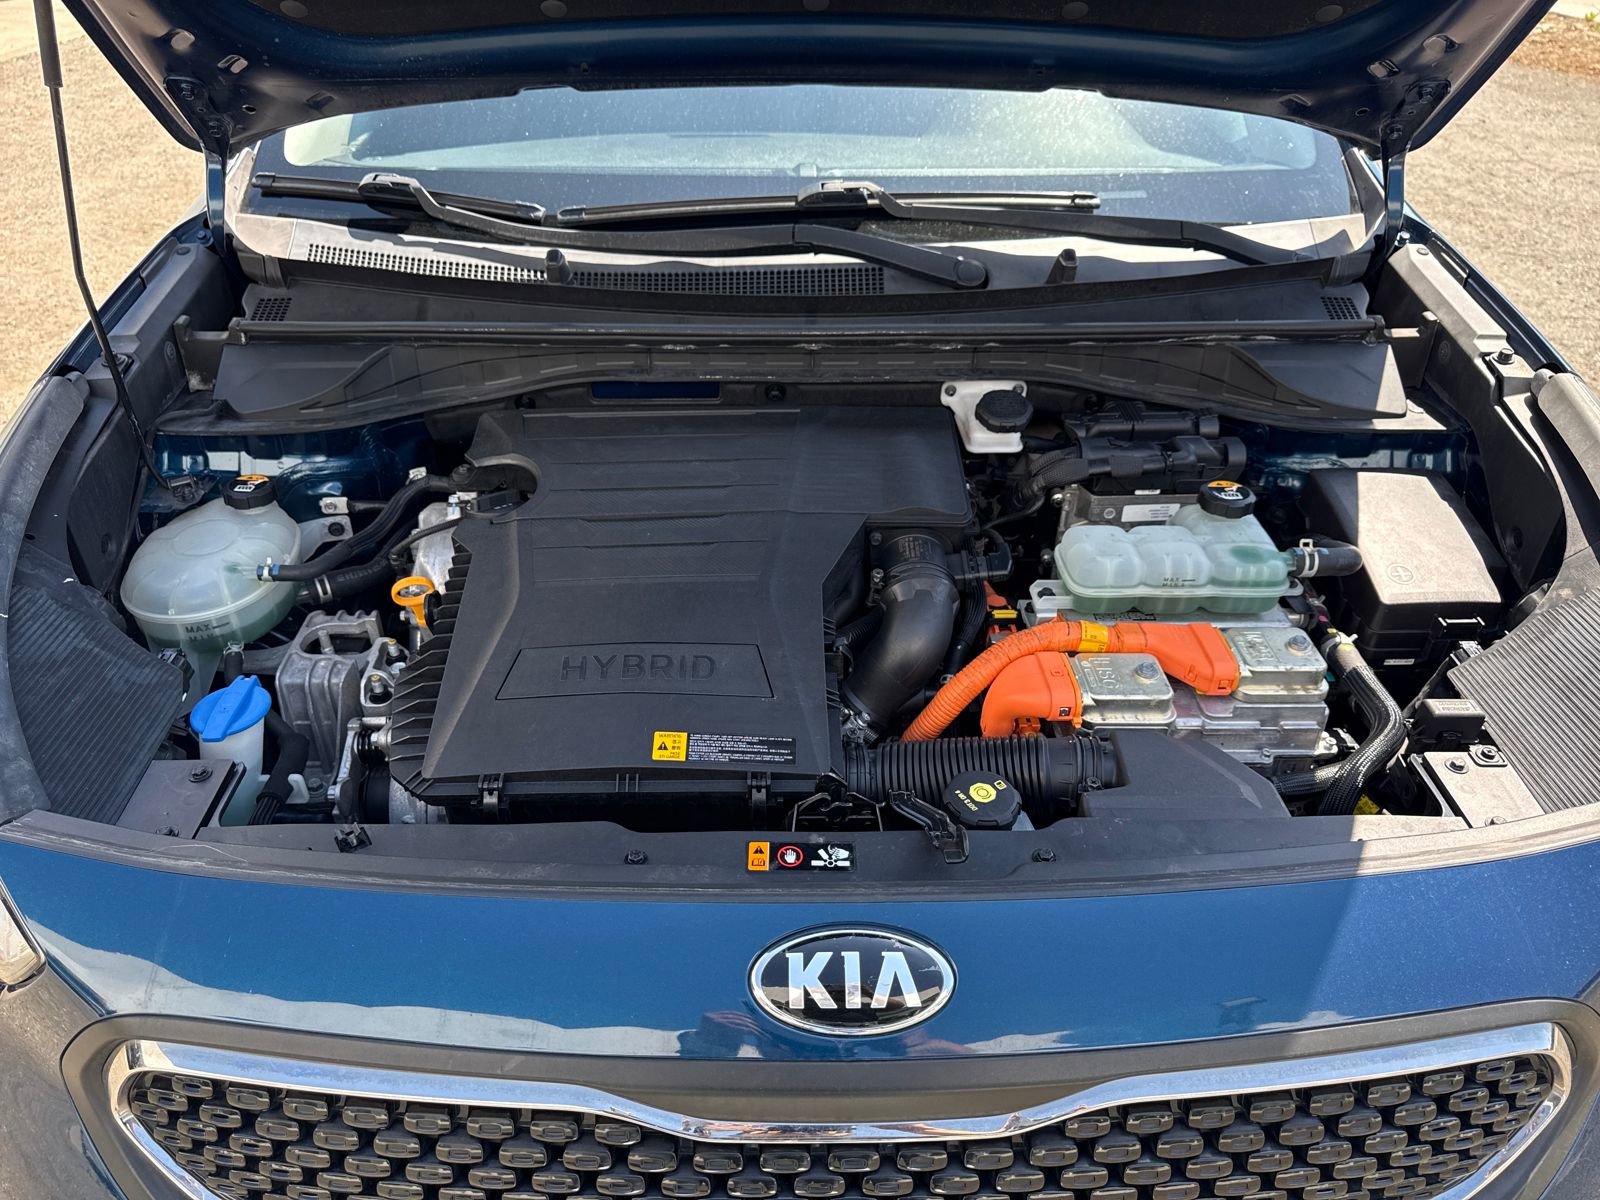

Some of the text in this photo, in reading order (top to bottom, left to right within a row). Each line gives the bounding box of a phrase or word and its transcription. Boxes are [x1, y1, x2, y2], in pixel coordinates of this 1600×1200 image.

[185, 624, 211, 633] MAX
[560, 654, 717, 681] HYBRID
[785, 951, 922, 1009] KIA
